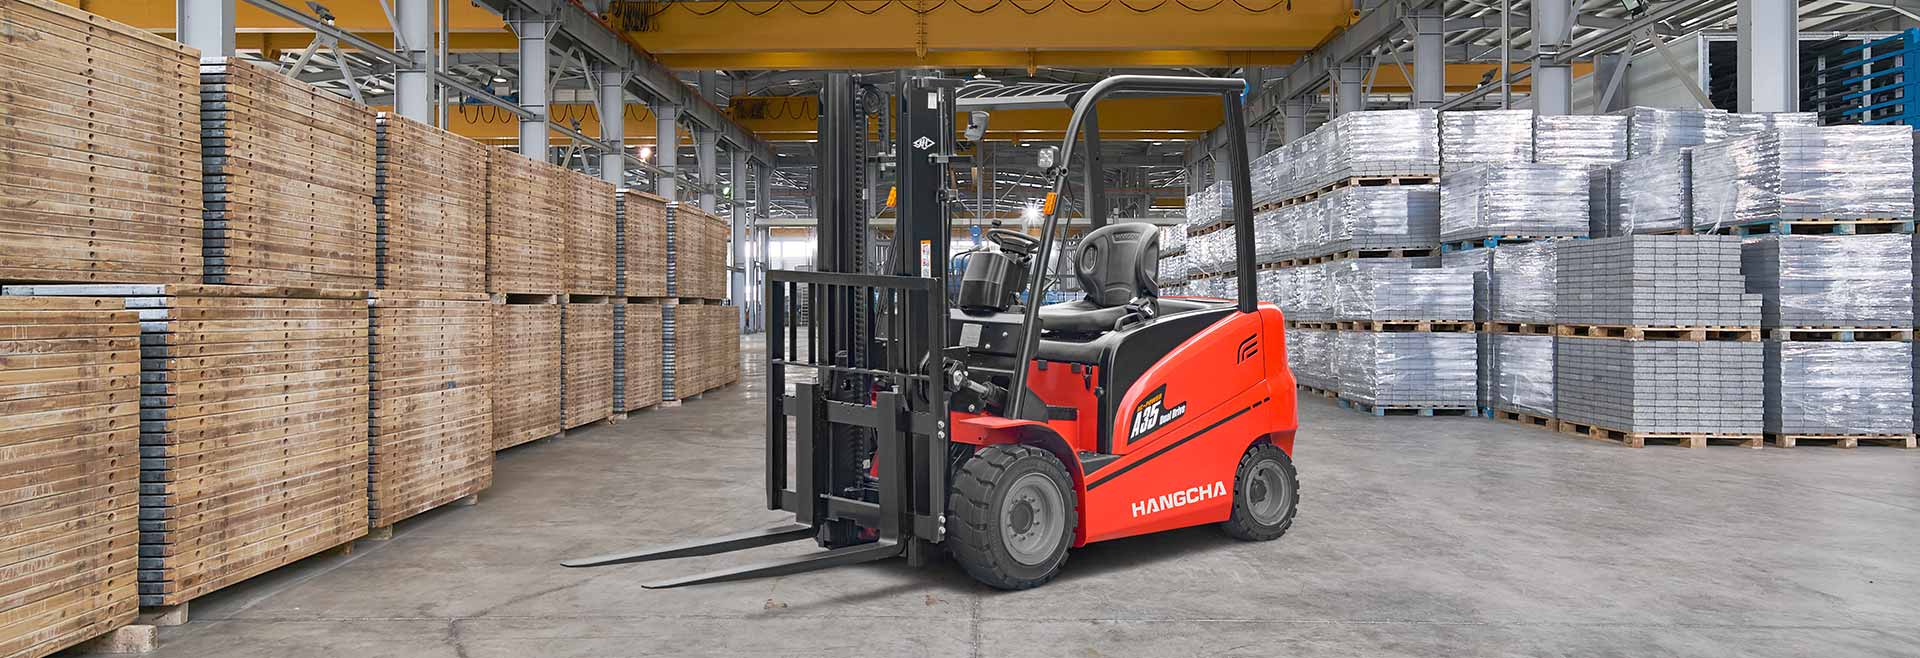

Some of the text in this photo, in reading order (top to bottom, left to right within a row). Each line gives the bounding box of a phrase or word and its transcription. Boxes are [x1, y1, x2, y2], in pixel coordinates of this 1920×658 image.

[1130, 400, 1162, 439] A35
[1171, 404, 1186, 420] Drive
[1131, 480, 1227, 518] HANGCHA
